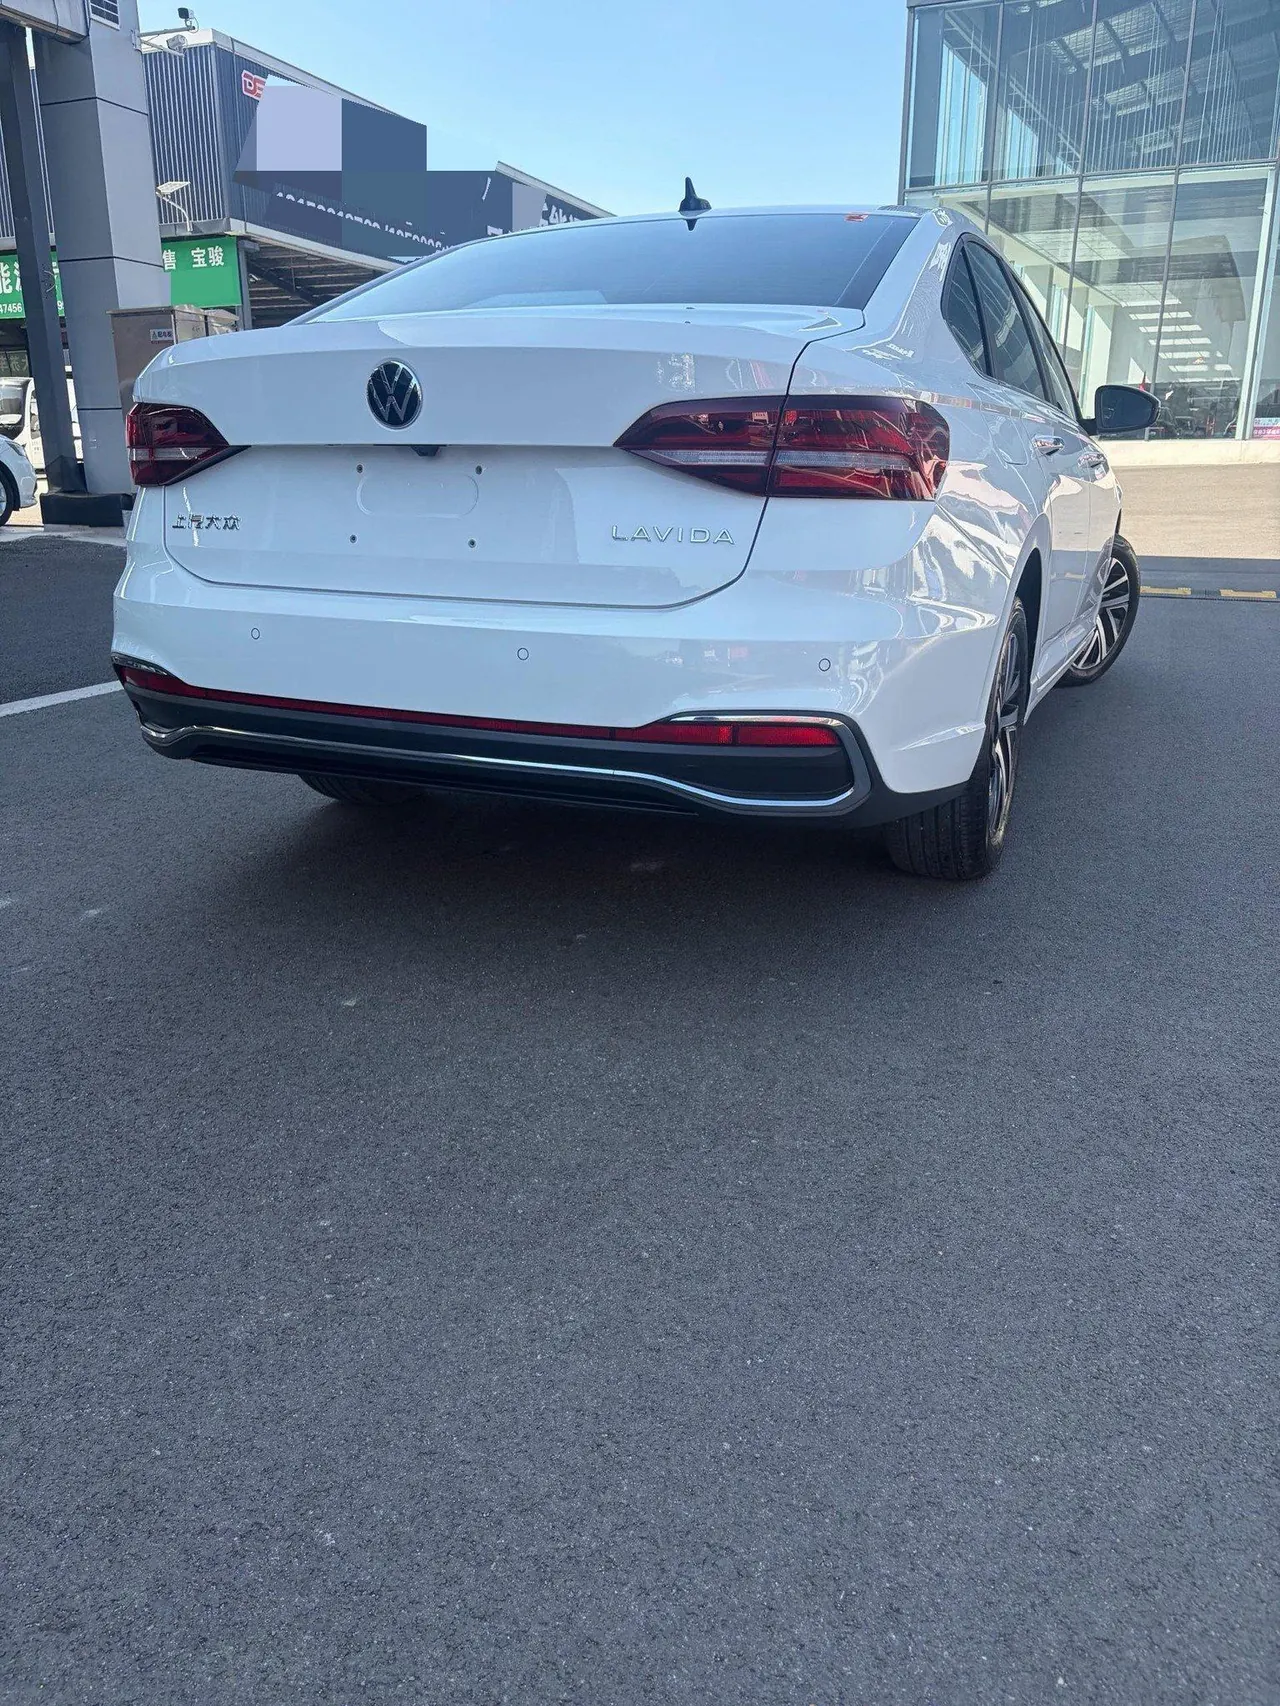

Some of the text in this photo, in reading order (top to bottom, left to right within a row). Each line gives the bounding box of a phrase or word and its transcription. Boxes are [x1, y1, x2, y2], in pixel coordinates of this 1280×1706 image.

[191, 245, 225, 269] 宝骏
[171, 513, 242, 530] 上汽大众
[611, 525, 735, 544] LAVIDA
